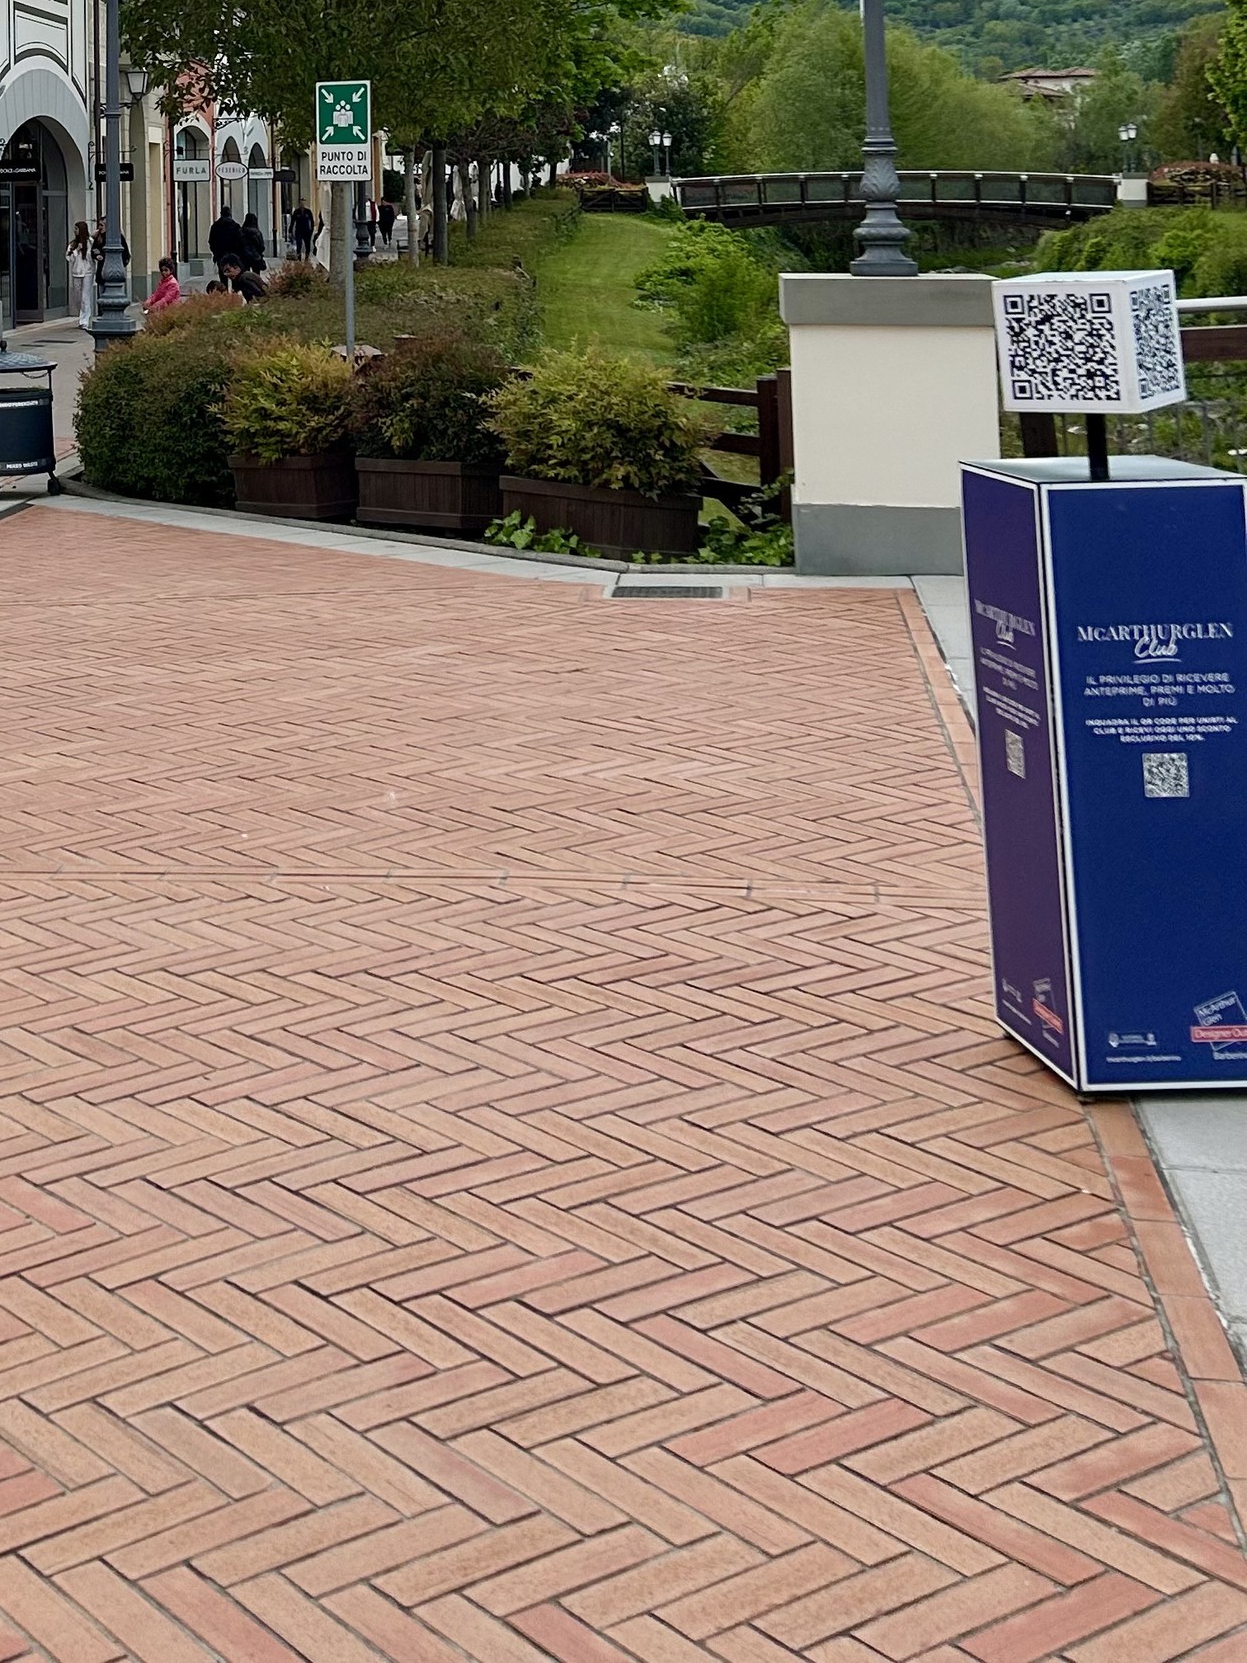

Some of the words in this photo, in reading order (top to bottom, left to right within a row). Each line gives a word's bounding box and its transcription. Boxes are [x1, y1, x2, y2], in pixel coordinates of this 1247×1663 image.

[321, 151, 353, 161] PUNTO
[357, 151, 367, 161] DI
[176, 166, 207, 175] FURLA
[319, 165, 368, 175] RACCOLTA
[1134, 636, 1178, 658] Club
[1099, 674, 1160, 685] PRIVILEGIO
[1161, 673, 1174, 683] DI
[1176, 673, 1229, 683] RICEVERE
[1150, 686, 1185, 694] PREMI
[1186, 685, 1195, 694] E
[1196, 684, 1236, 694] MOLTO
[1142, 697, 1155, 707] DI
[1178, 717, 1195, 725] PER
[1093, 727, 1117, 735] CLUB
[1196, 725, 1232, 733] SCONTO
[1120, 735, 1167, 743] ESCLUSIVO
[1167, 734, 1185, 742] DEL
[1198, 997, 1236, 1017] McArthur
[1203, 1013, 1223, 1026] Glen
[1194, 1029, 1232, 1039] Designer
